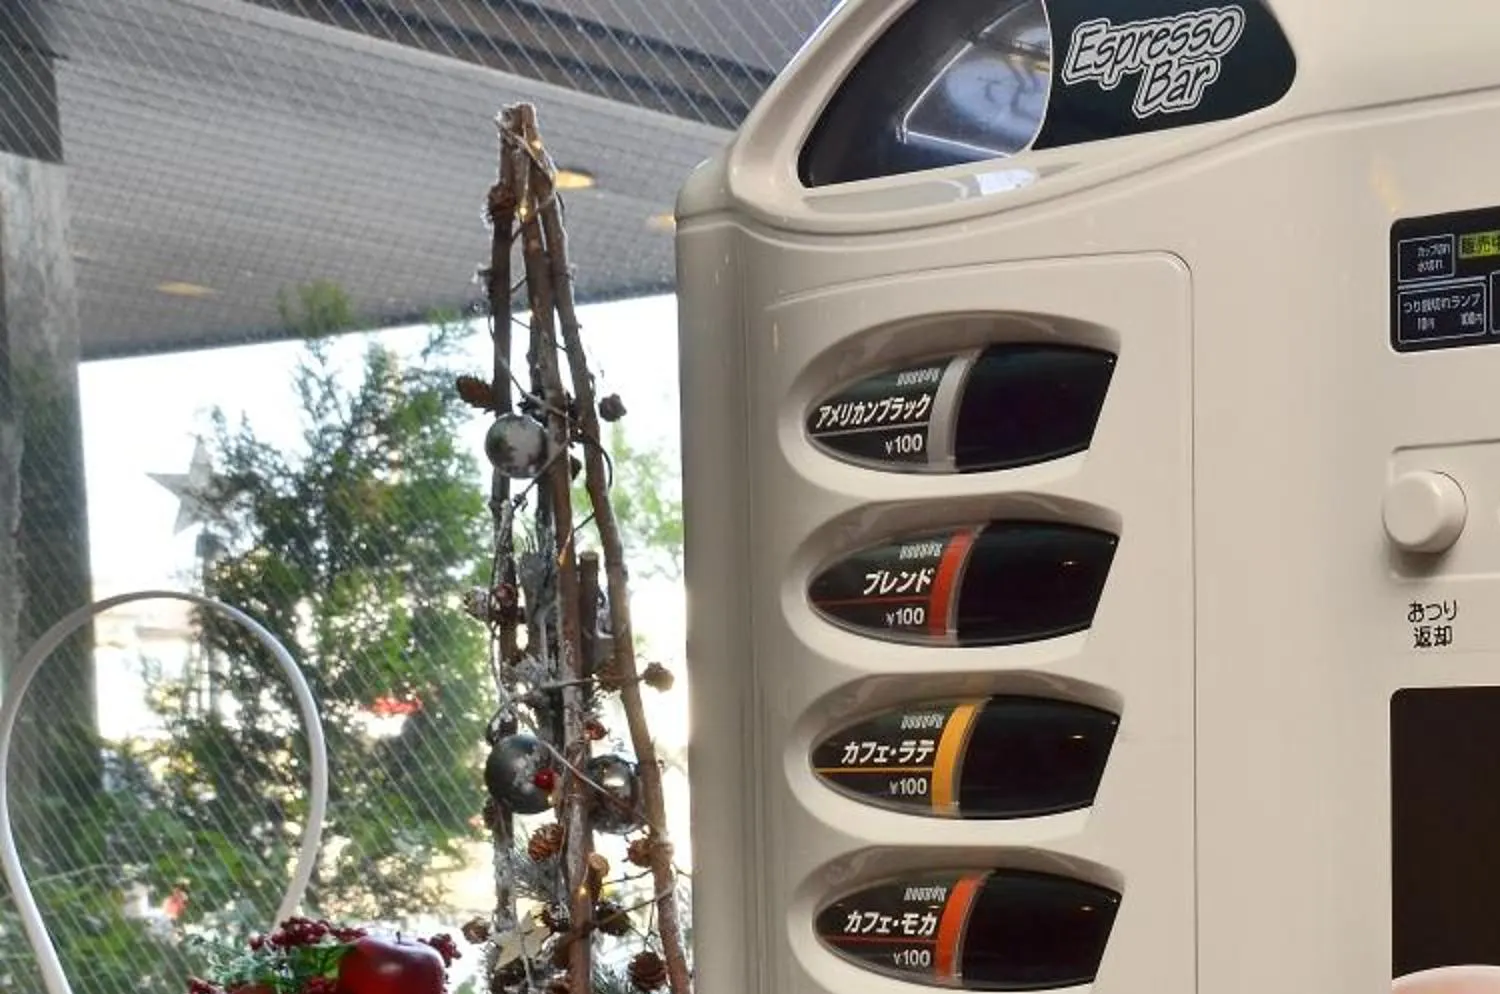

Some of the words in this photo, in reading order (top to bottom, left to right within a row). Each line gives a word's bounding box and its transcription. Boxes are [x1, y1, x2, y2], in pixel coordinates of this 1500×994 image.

[1066, 10, 1240, 88] Espresso
[1140, 58, 1212, 106] Bar
[815, 393, 932, 429] アメリカンブラック
[885, 433, 923, 455] ¥100
[863, 567, 936, 596] ブレンド
[885, 607, 925, 628] ¥100
[1407, 600, 1458, 623] おつり
[1412, 625, 1454, 649] 返却
[841, 739, 935, 765] カフェ・ラテ
[889, 777, 928, 796] ¥100
[844, 909, 938, 936] カフェ・モカ
[893, 949, 931, 968] ¥100
